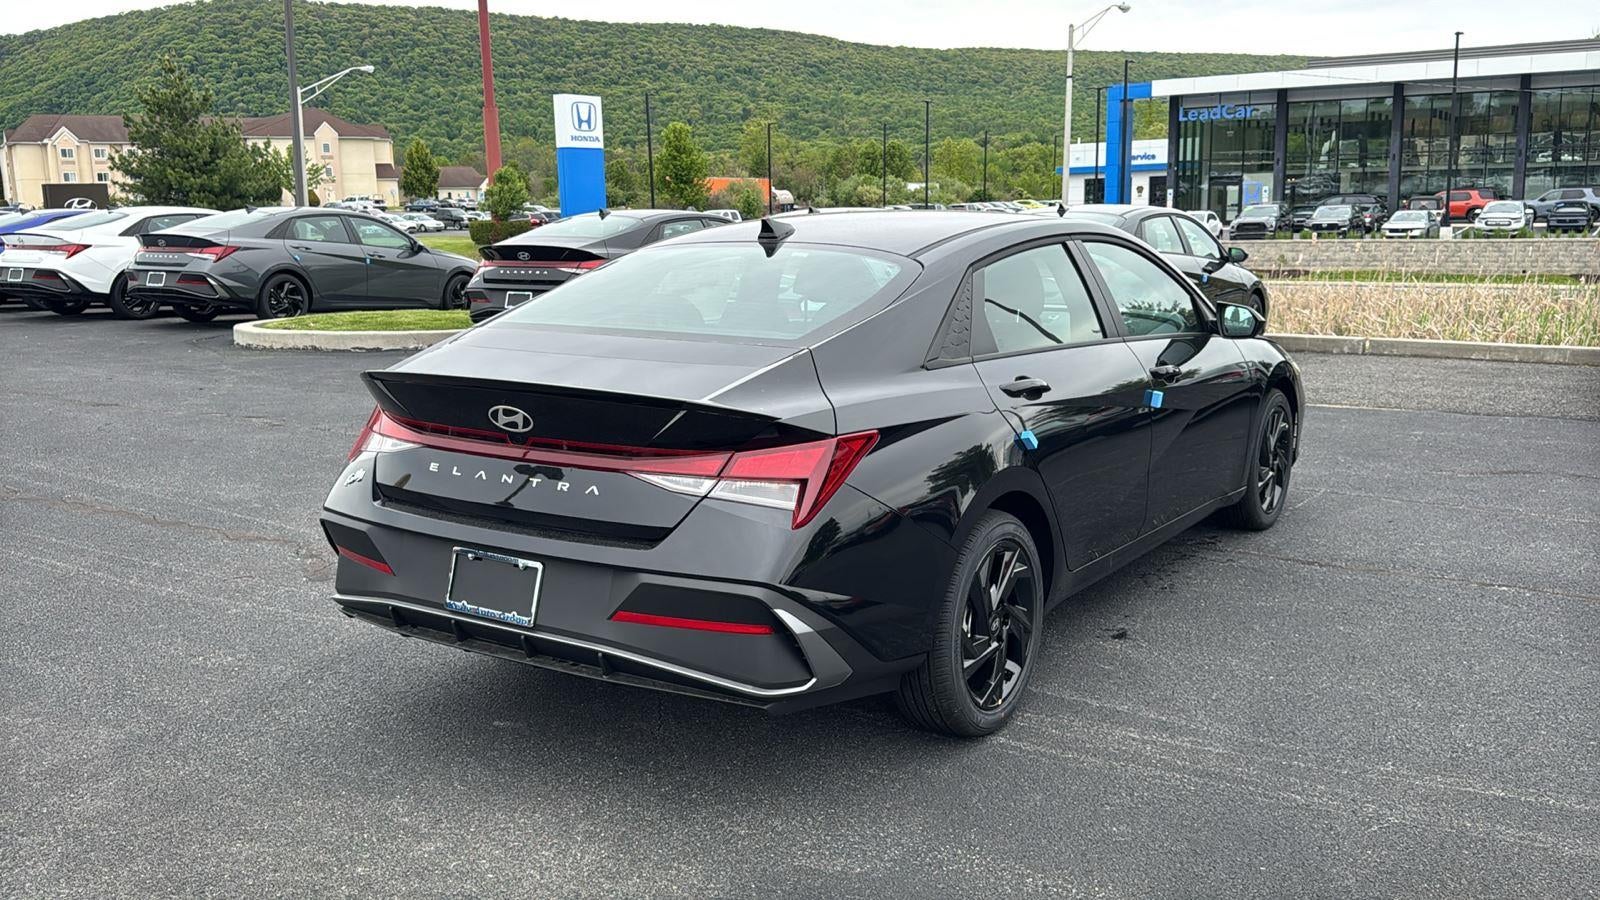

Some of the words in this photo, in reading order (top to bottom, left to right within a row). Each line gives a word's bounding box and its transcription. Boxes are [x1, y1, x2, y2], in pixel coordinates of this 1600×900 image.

[1179, 104, 1254, 122] LeadCar
[1131, 152, 1156, 161] ervice
[429, 462, 599, 495] ELANTRA
